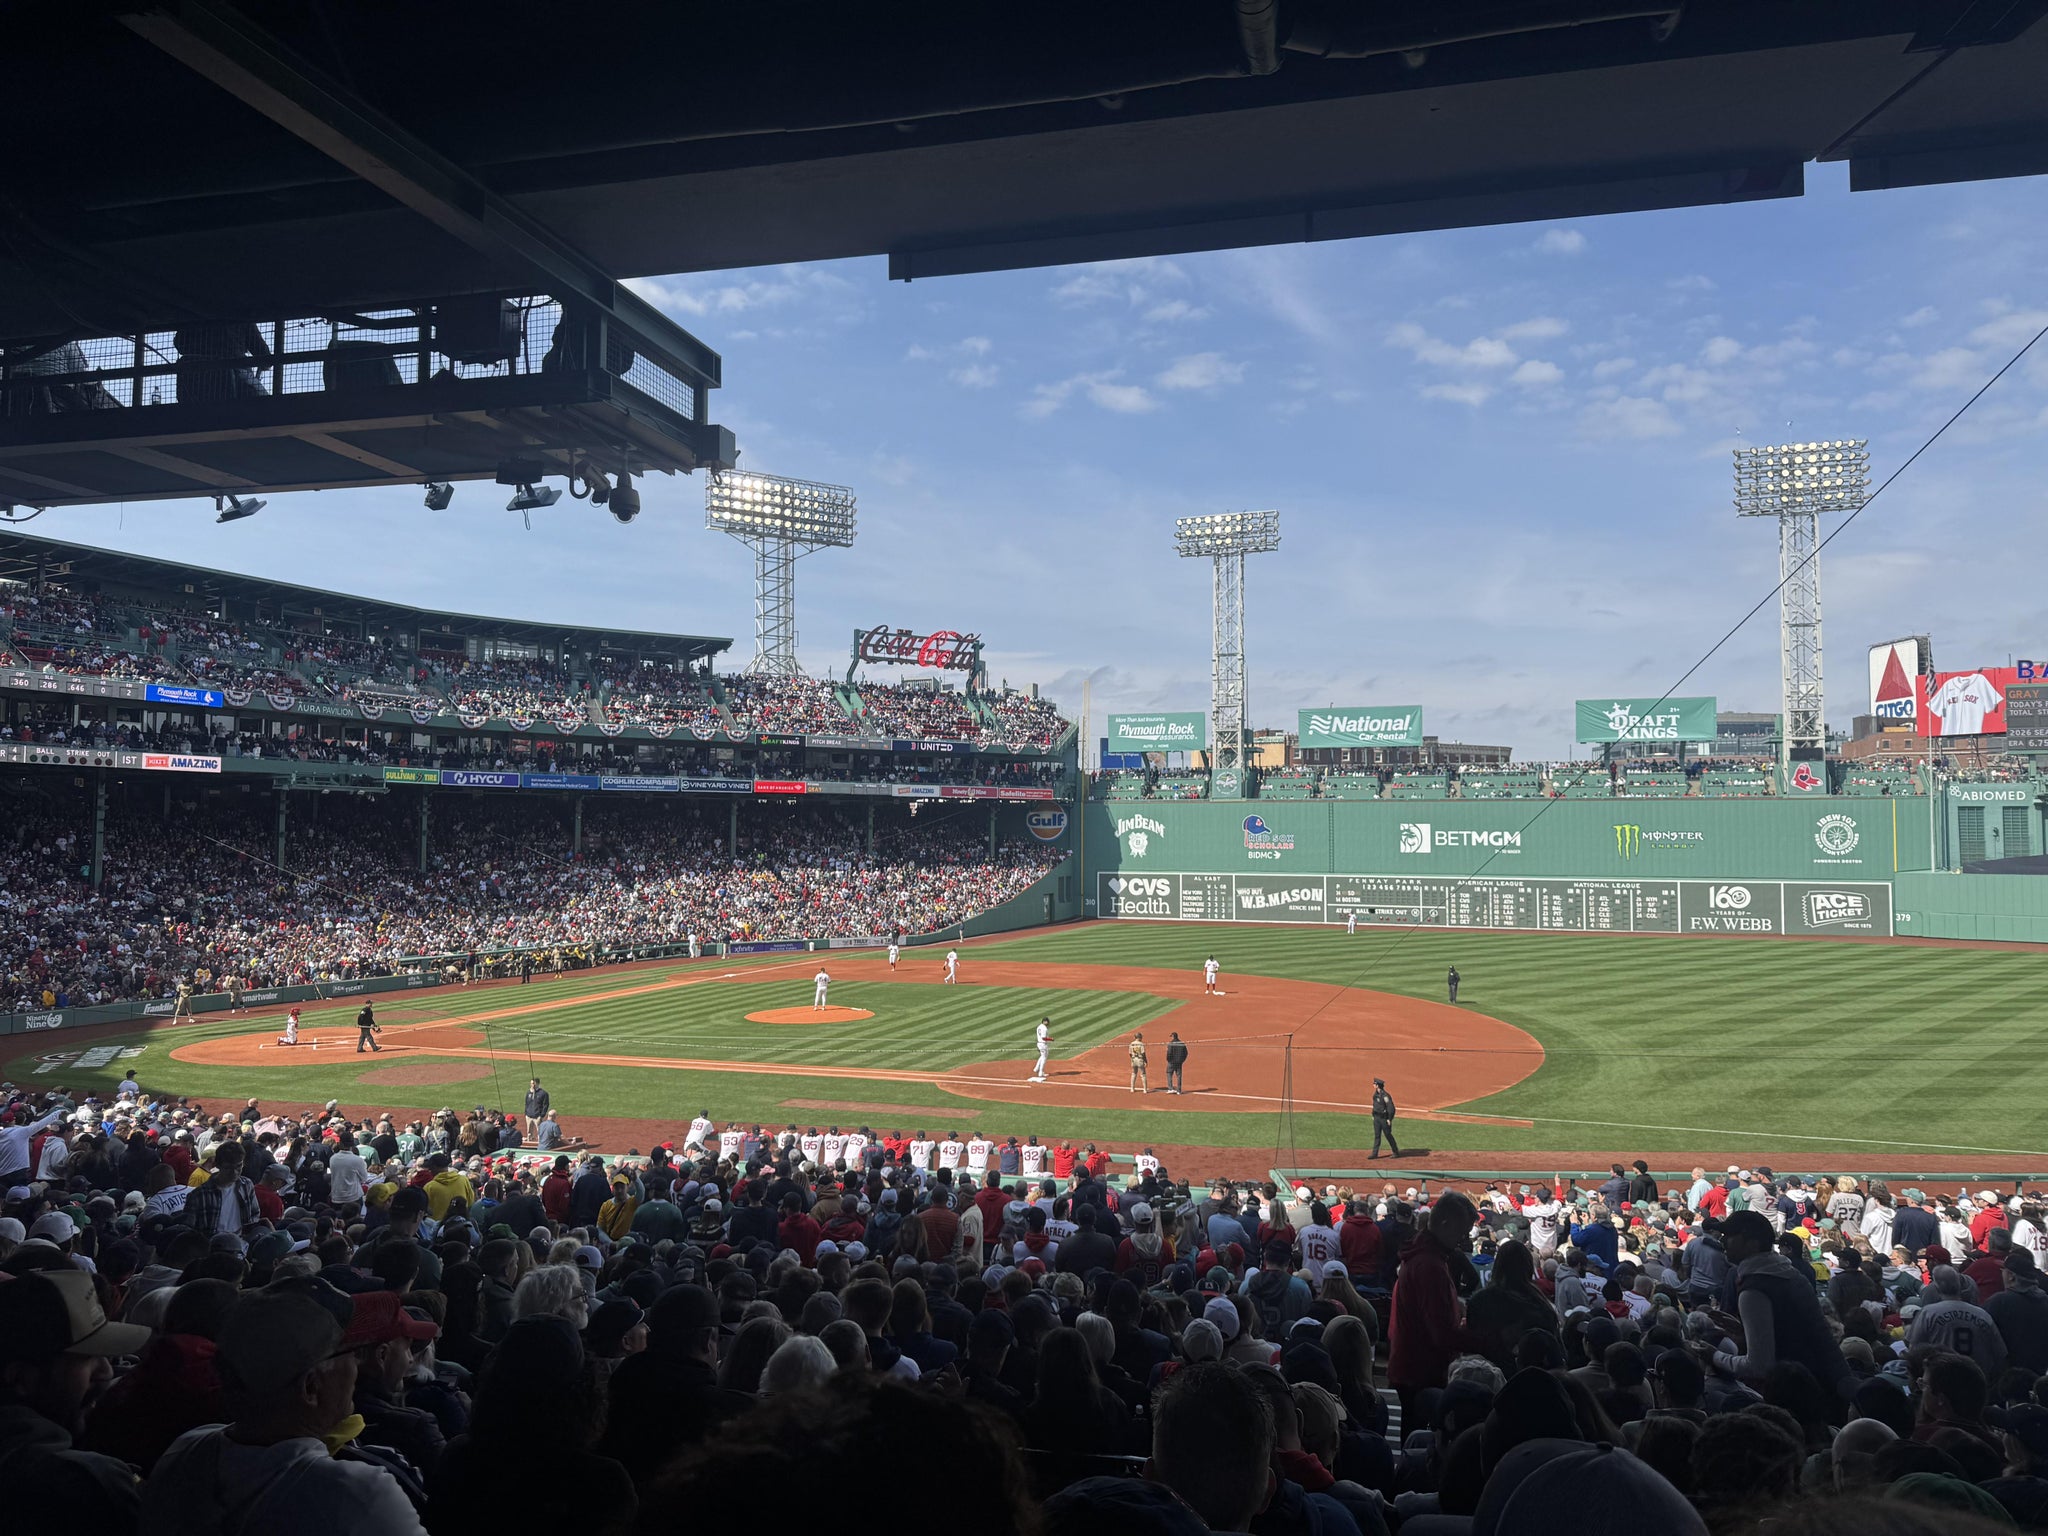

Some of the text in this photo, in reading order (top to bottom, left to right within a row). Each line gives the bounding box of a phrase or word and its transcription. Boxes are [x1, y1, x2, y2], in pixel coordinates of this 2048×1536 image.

[10, 678, 29, 687] .360
[39, 681, 57, 689] .286
[67, 684, 85, 692] .646
[157, 687, 183, 696] Plymouth
[2008, 690, 2040, 699] GRAY
[1875, 699, 1914, 718] CITGO
[2009, 700, 2043, 708] TODAY'S
[322, 706, 354, 717] PAVILION
[1608, 714, 1680, 730] DRAFT
[1118, 722, 1195, 737] Plymouth Rock
[1617, 727, 1679, 739] KINGS
[1376, 732, 1407, 740] Rental
[36, 747, 55, 755] BALL
[66, 749, 90, 757] STRIKE
[920, 743, 954, 752] UNITED
[0, 750, 6, 758] R
[170, 757, 218, 769] AMAZING
[385, 770, 438, 782] SULLIVAN TIRE
[469, 775, 504, 784] HYCU
[635, 778, 678, 786] COMPANIES
[1000, 790, 1026, 798] Safelite
[1961, 790, 2026, 801] ABIOMED
[1028, 813, 1065, 826] Gulf
[1841, 815, 1857, 828] 103
[1114, 813, 1166, 839] JIM BEAM
[1248, 834, 1295, 842] RED SOX
[1435, 830, 1521, 847] BETMGM
[1642, 830, 1704, 841] MONSTER
[1248, 842, 1295, 850] SCHOLARS
[1248, 851, 1273, 860] BIDMC
[1128, 877, 1171, 896] CVS
[1709, 885, 1751, 909] 160
[1815, 893, 1863, 910] ACE
[1110, 896, 1171, 915] Health
[1816, 908, 1864, 920] TICKET
[1895, 913, 1911, 922] 379
[1690, 917, 1773, 931] F.W. WEBB
[345, 985, 364, 993] TICKET
[241, 992, 279, 1003] smartwater
[143, 1003, 174, 1014] Franklin
[26, 1021, 47, 1029] Nine
[400, 1140, 415, 1153] 34
[826, 1140, 839, 1150] 23
[849, 1136, 864, 1146] 29
[912, 1145, 925, 1155] 71
[942, 1145, 957, 1155] 43
[1024, 1151, 1039, 1161] 32
[1142, 1159, 1156, 1169] 84
[1765, 1197, 1775, 1210] 7
[1795, 1202, 1806, 1215] 9
[1838, 1207, 1858, 1221] 27
[1045, 1227, 1072, 1238] AFAELA
[2033, 1236, 2048, 1251] 19
[1307, 1242, 1327, 1260] 16
[1582, 1281, 1601, 1292] SHIDA
[1954, 1327, 1973, 1354] 8
